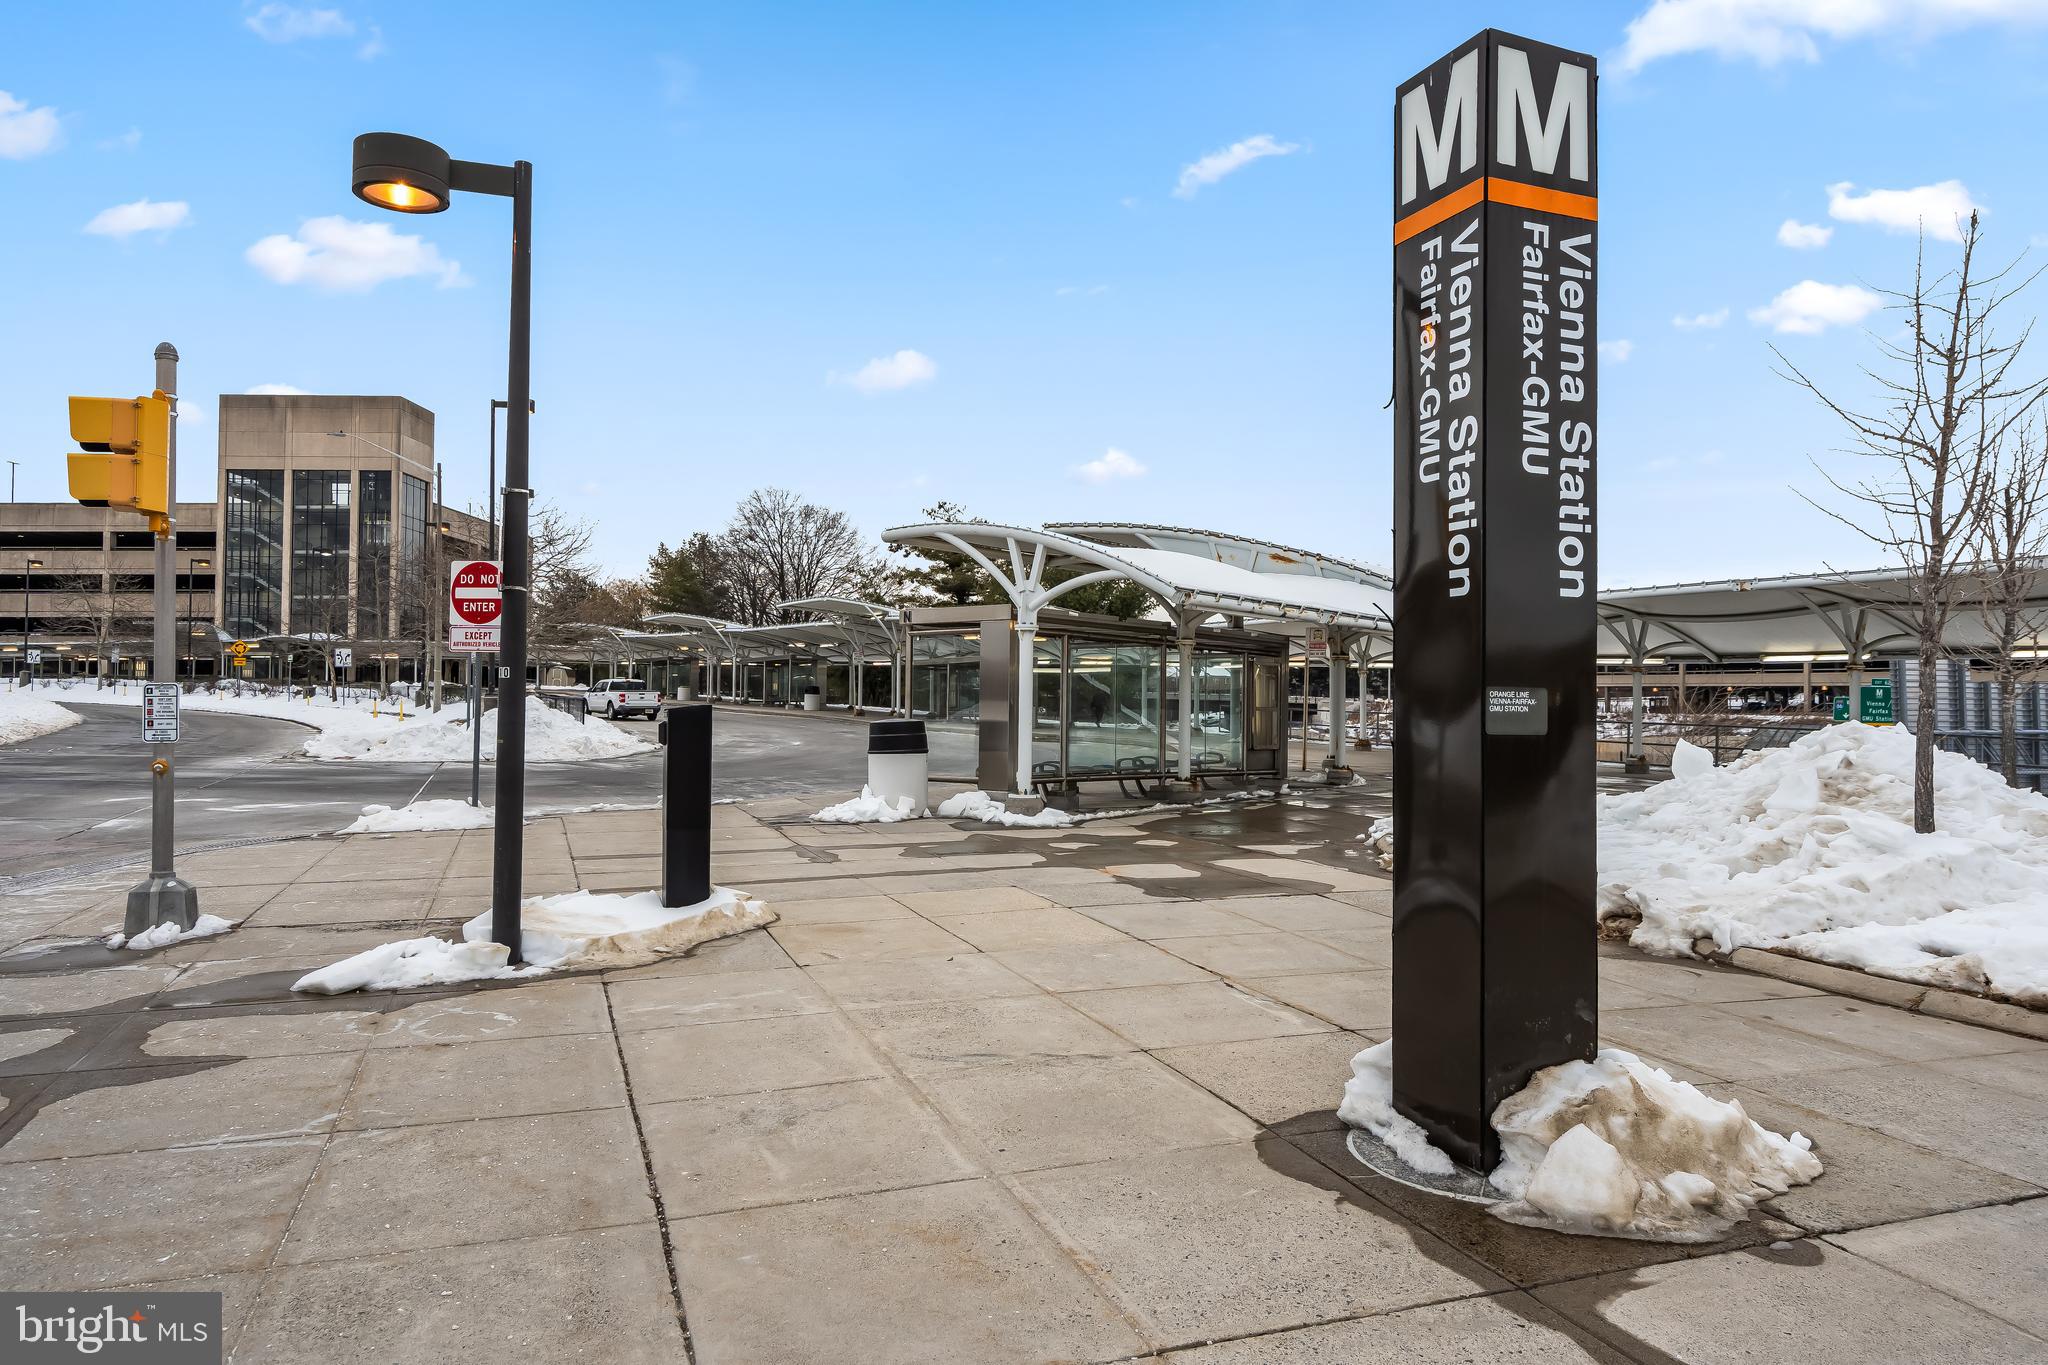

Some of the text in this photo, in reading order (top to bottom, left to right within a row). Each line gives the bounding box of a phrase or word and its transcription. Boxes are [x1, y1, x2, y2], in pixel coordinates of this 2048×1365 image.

[1402, 48, 1478, 205] M
[1497, 45, 1588, 181] M
[1419, 235, 1443, 483] Fairfax-GMU
[1448, 218, 1479, 598] Vienna Station
[1522, 221, 1550, 475] Fairfax-GMU
[1558, 233, 1592, 598] Vienna Station
[460, 574, 474, 584] DO
[463, 602, 495, 612] ENTER
[464, 631, 492, 640] EXCEPT
